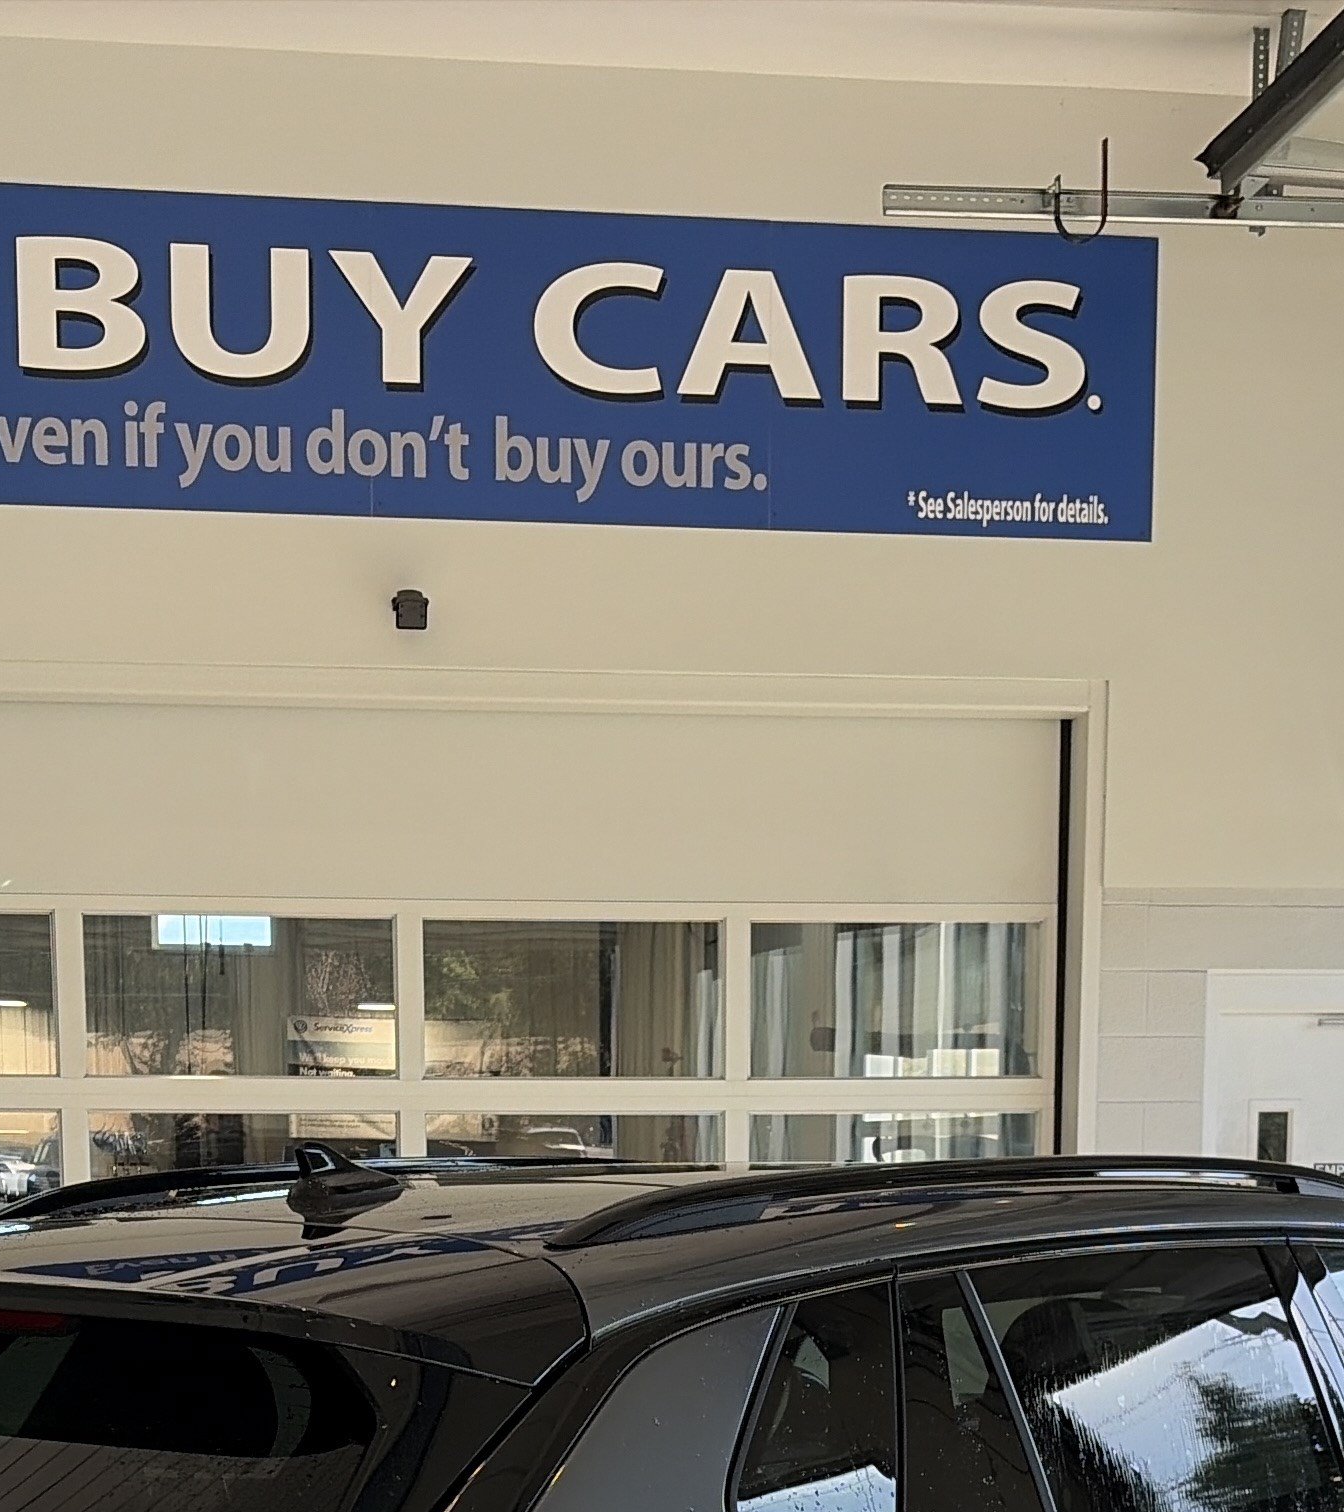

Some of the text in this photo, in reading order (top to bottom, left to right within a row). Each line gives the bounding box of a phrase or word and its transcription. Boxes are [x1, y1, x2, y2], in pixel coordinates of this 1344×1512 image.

[14, 235, 475, 391] BUY
[533, 261, 1102, 416] CARS.
[123, 400, 166, 469] if
[175, 416, 292, 489] you
[306, 408, 470, 480] don't
[494, 415, 611, 503] buy
[620, 438, 768, 492] ours.
[946, 490, 1032, 528] Salesperson
[1033, 492, 1056, 523] for
[1057, 493, 1110, 525] details.
[312, 1021, 373, 1034] ServiceXpress
